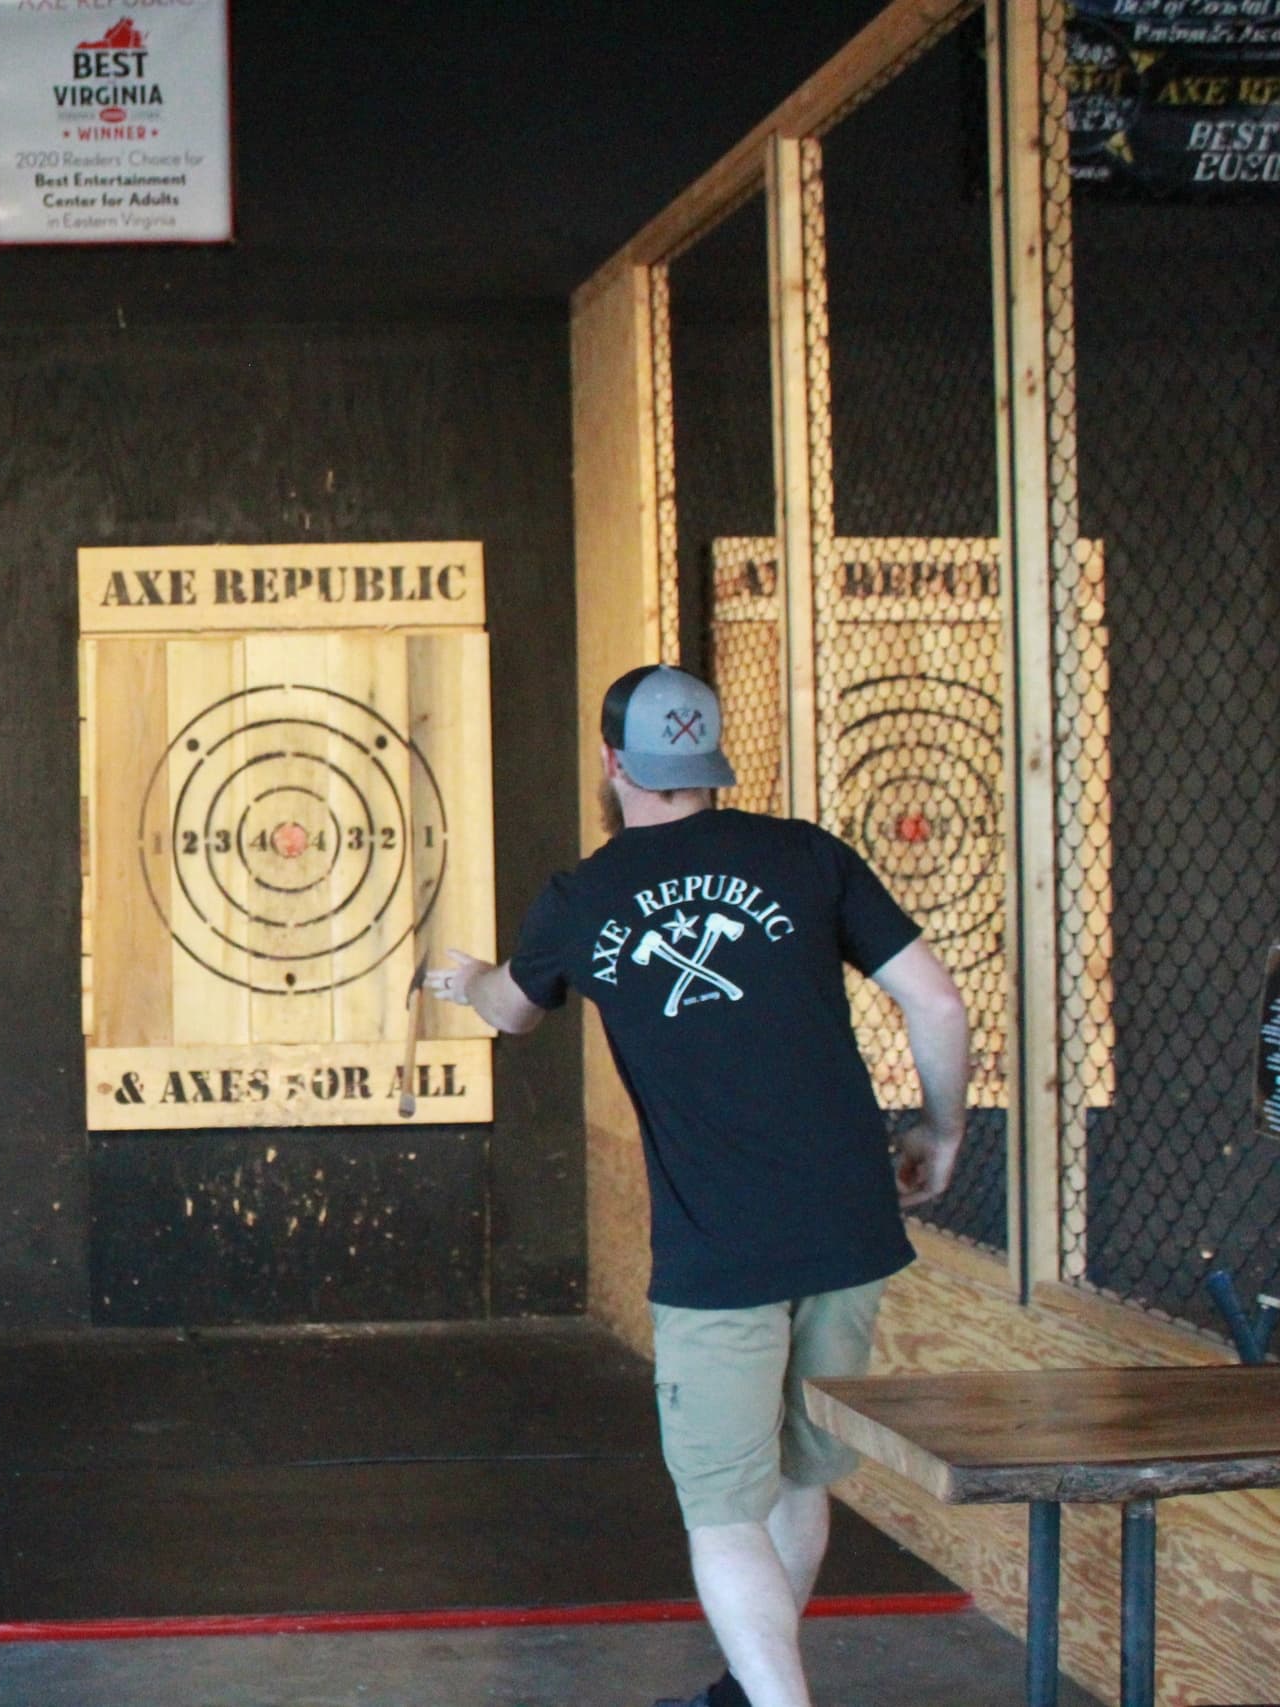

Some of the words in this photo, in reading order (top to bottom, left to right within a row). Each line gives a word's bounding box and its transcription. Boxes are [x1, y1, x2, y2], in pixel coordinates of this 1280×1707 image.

[73, 51, 148, 80] BEST
[54, 84, 163, 107] VIRGINIA
[77, 126, 147, 141] WINNER
[1186, 120, 1280, 151] BEST
[16, 152, 59, 169] 2020
[128, 151, 181, 167] Choice
[185, 151, 205, 167] for
[35, 174, 69, 187] Best
[74, 172, 187, 187] Entertainment
[43, 194, 96, 208] Center
[102, 192, 123, 206] for
[129, 192, 180, 207] Adults
[47, 215, 60, 228] in
[63, 212, 119, 229] Eastern
[122, 212, 176, 230] Virginia
[100, 569, 197, 607] AXE
[213, 564, 468, 605] REPUBLIC
[182, 832, 198, 854] 2
[215, 830, 231, 853] 3
[249, 831, 267, 851] 4
[348, 826, 363, 849] 3
[380, 828, 396, 849] 2
[424, 826, 434, 848] 1
[592, 918, 632, 986] AXE
[634, 874, 795, 943] REPUBLIC
[114, 1071, 145, 1104] &
[158, 1069, 270, 1103] AXES
